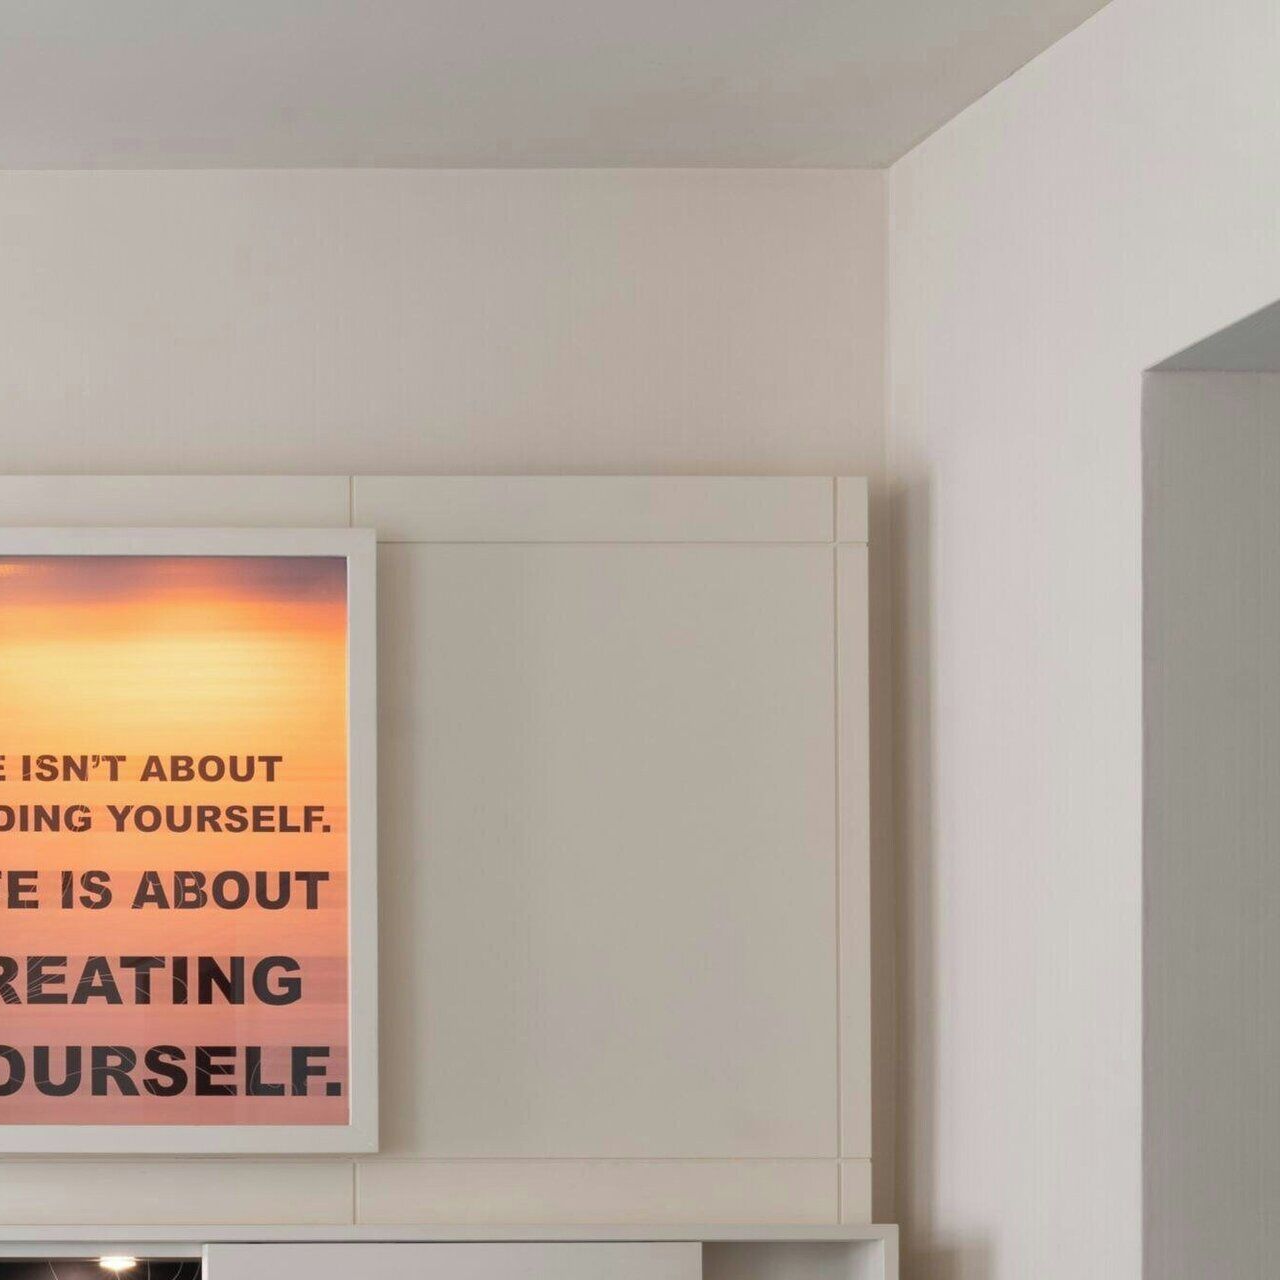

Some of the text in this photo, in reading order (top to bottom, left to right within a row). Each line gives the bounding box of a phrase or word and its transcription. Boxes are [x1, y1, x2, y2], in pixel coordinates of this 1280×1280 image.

[22, 754, 127, 782] ISN’T
[139, 755, 283, 782] ABOUT
[106, 804, 332, 833] YOURSELF.
[60, 869, 114, 910] IS
[130, 870, 330, 910] ABOUT
